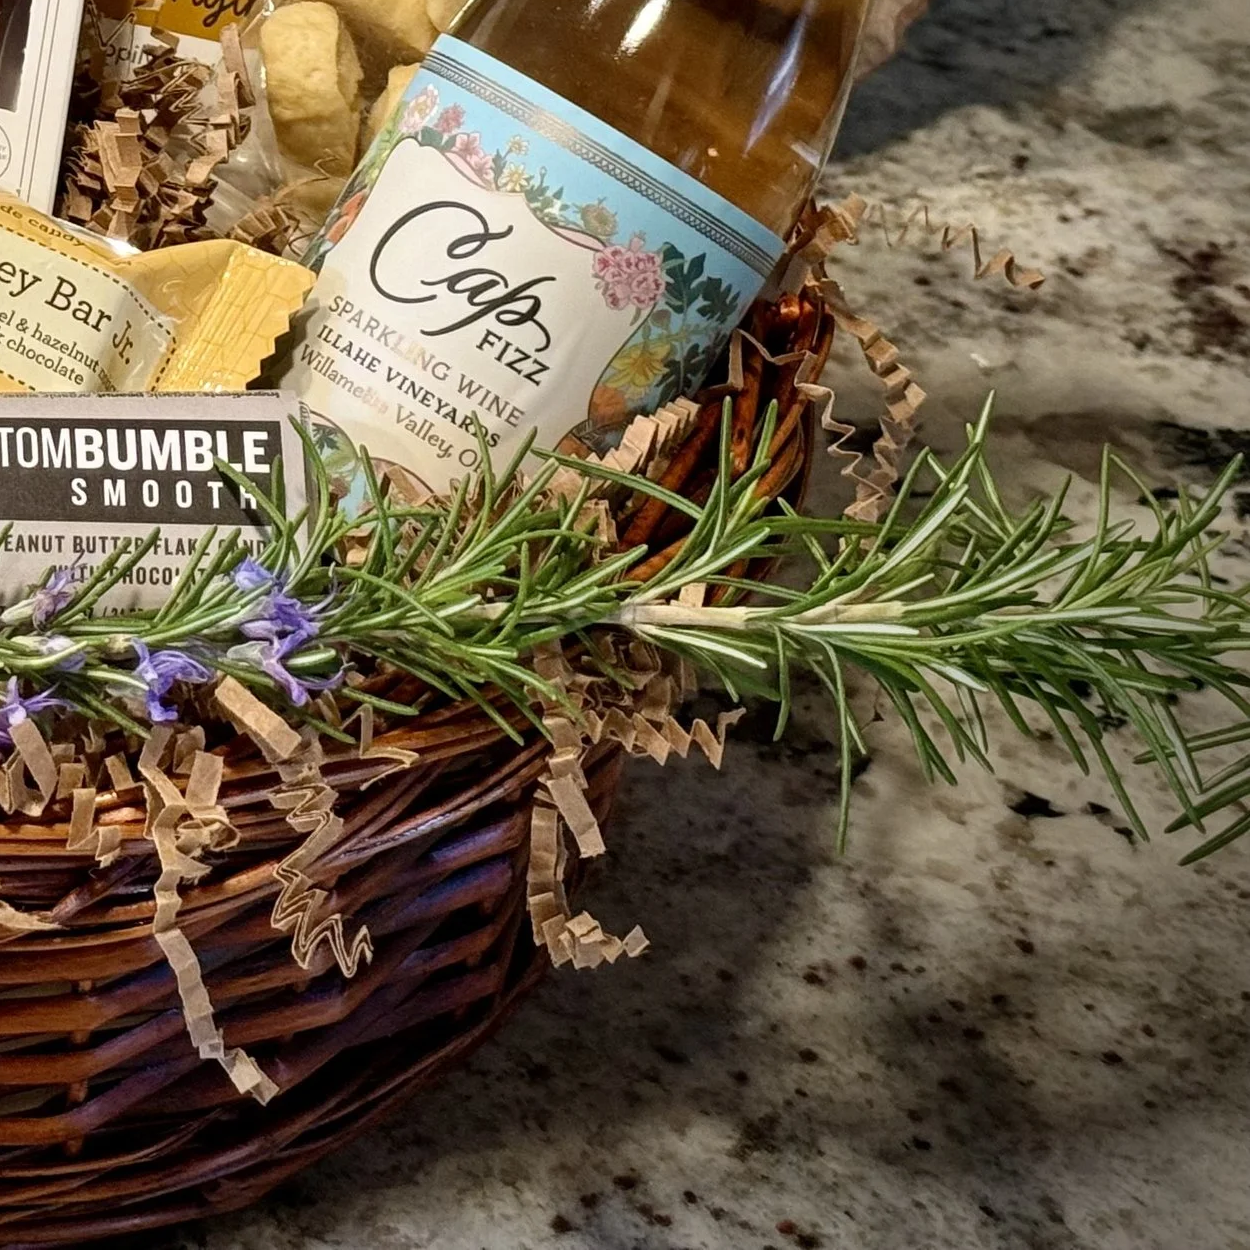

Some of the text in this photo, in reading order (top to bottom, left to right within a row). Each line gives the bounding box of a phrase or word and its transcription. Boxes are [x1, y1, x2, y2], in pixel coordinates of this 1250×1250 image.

[28, 218, 86, 247] candy
[370, 200, 556, 353] Cap
[16, 318, 30, 334] &
[31, 323, 101, 374] hazelnut
[44, 275, 112, 333] Bar
[112, 320, 136, 366] Jr.
[7, 336, 85, 386] chocolate
[317, 324, 381, 373] ILLAHE
[475, 329, 551, 386] FIZZ
[457, 374, 525, 428] WINE
[395, 403, 453, 459] Valley,
[154, 537, 211, 556] FLAK
